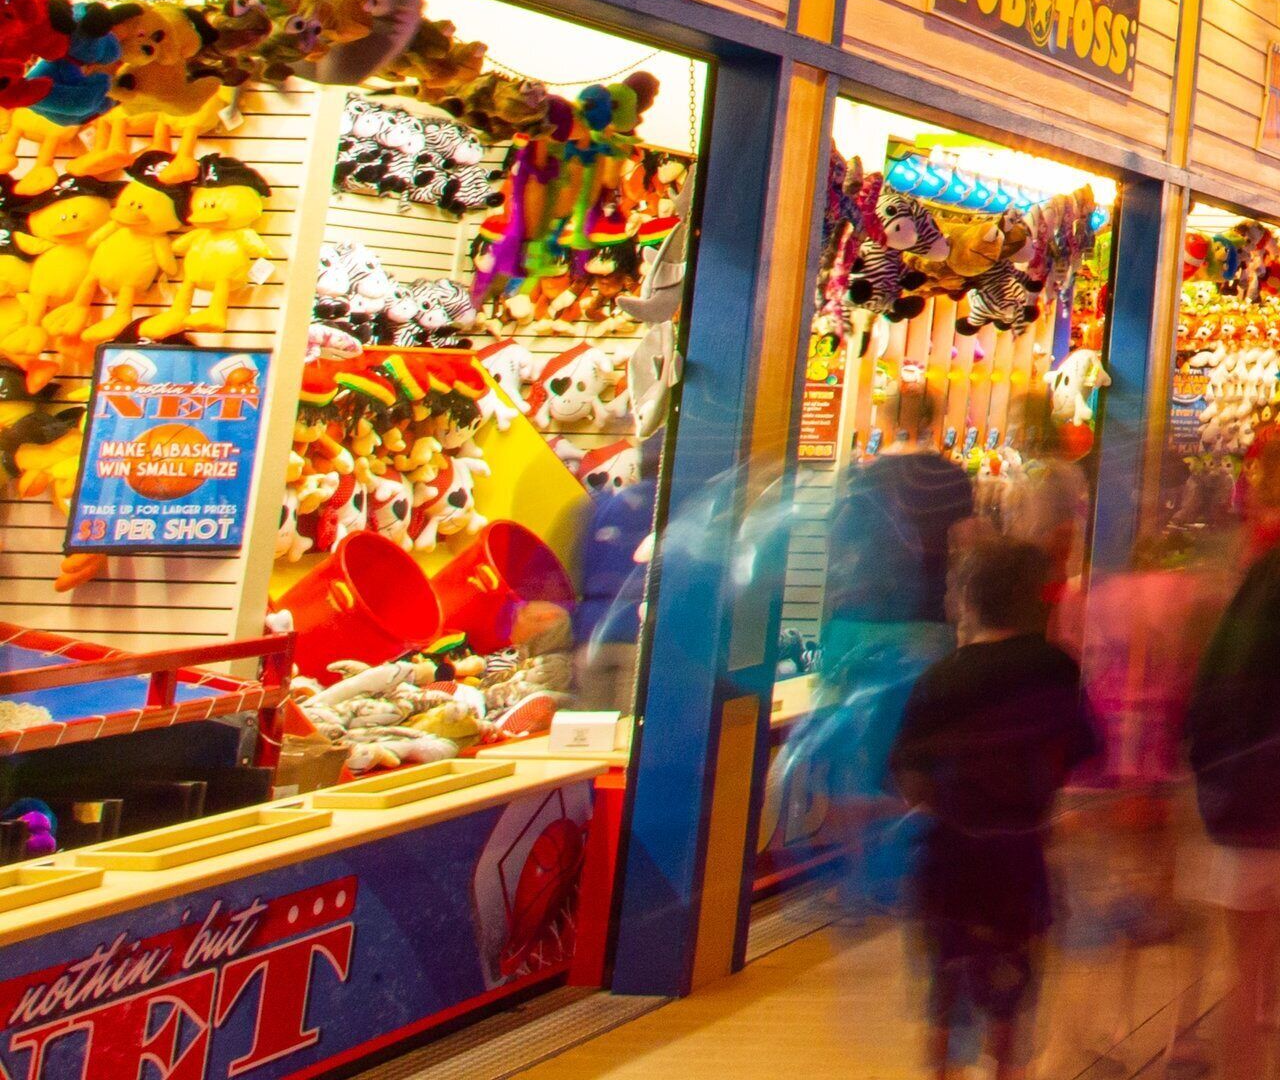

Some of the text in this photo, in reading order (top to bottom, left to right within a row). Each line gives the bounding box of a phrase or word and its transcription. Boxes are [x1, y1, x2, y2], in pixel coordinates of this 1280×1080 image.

[191, 381, 223, 395] but
[94, 394, 260, 421] NET
[101, 441, 146, 458] MAKE
[152, 442, 165, 457] A
[98, 461, 238, 477] WIN SMALL PRIZE
[82, 505, 238, 516] TRADE UP FOR LARGER PRIZES
[77, 518, 235, 542] $3 PER SHOT
[8, 897, 269, 1025] nothin' but
[0, 921, 355, 1080] ET
